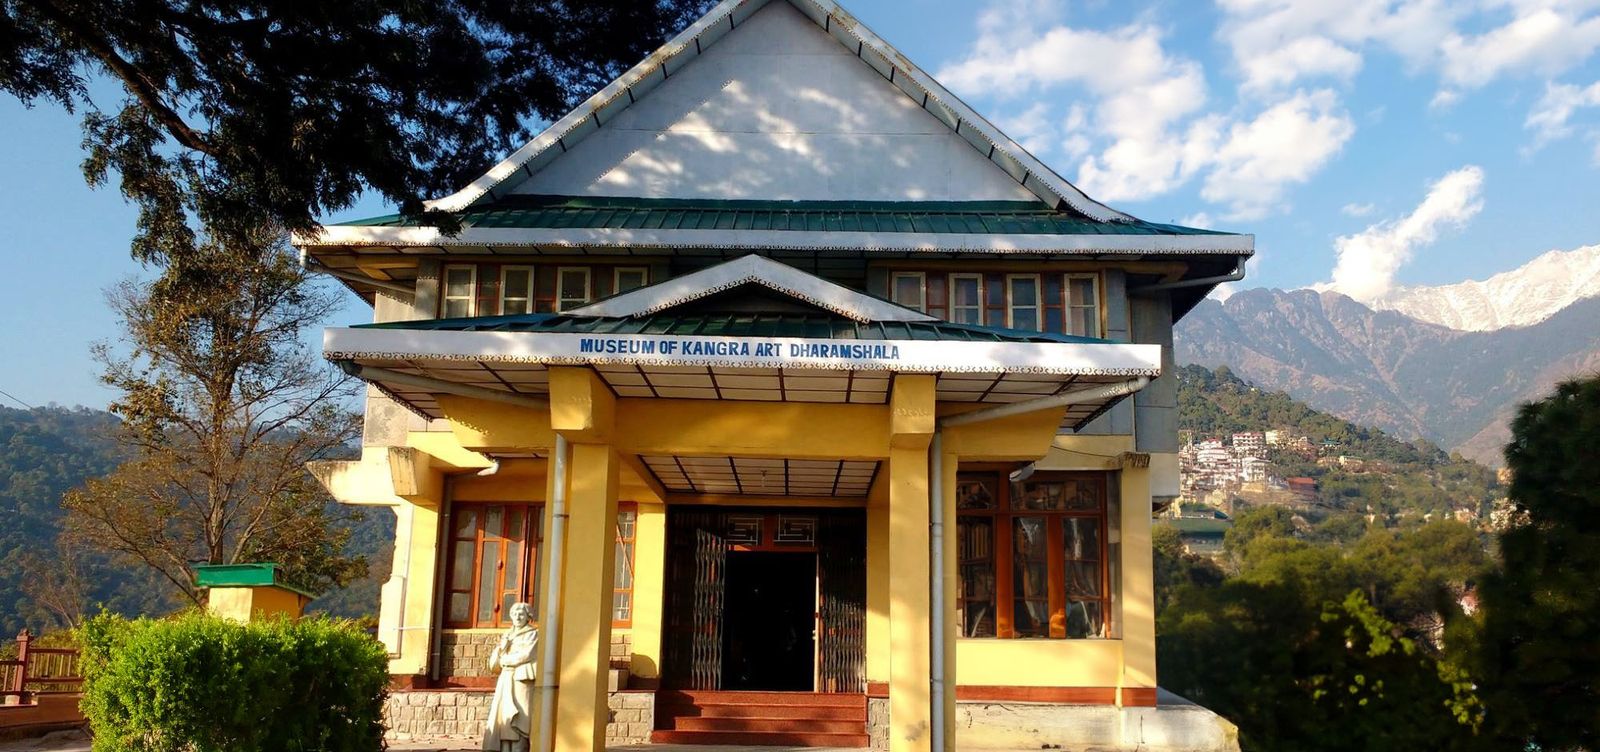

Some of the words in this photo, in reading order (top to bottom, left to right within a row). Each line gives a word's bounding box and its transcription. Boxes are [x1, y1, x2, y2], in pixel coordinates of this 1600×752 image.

[580, 338, 655, 354] MUSEUM
[659, 340, 678, 354] OF
[682, 341, 750, 356] KANGRA
[755, 343, 782, 357] ART
[790, 343, 900, 359] DHARAMSHALA
